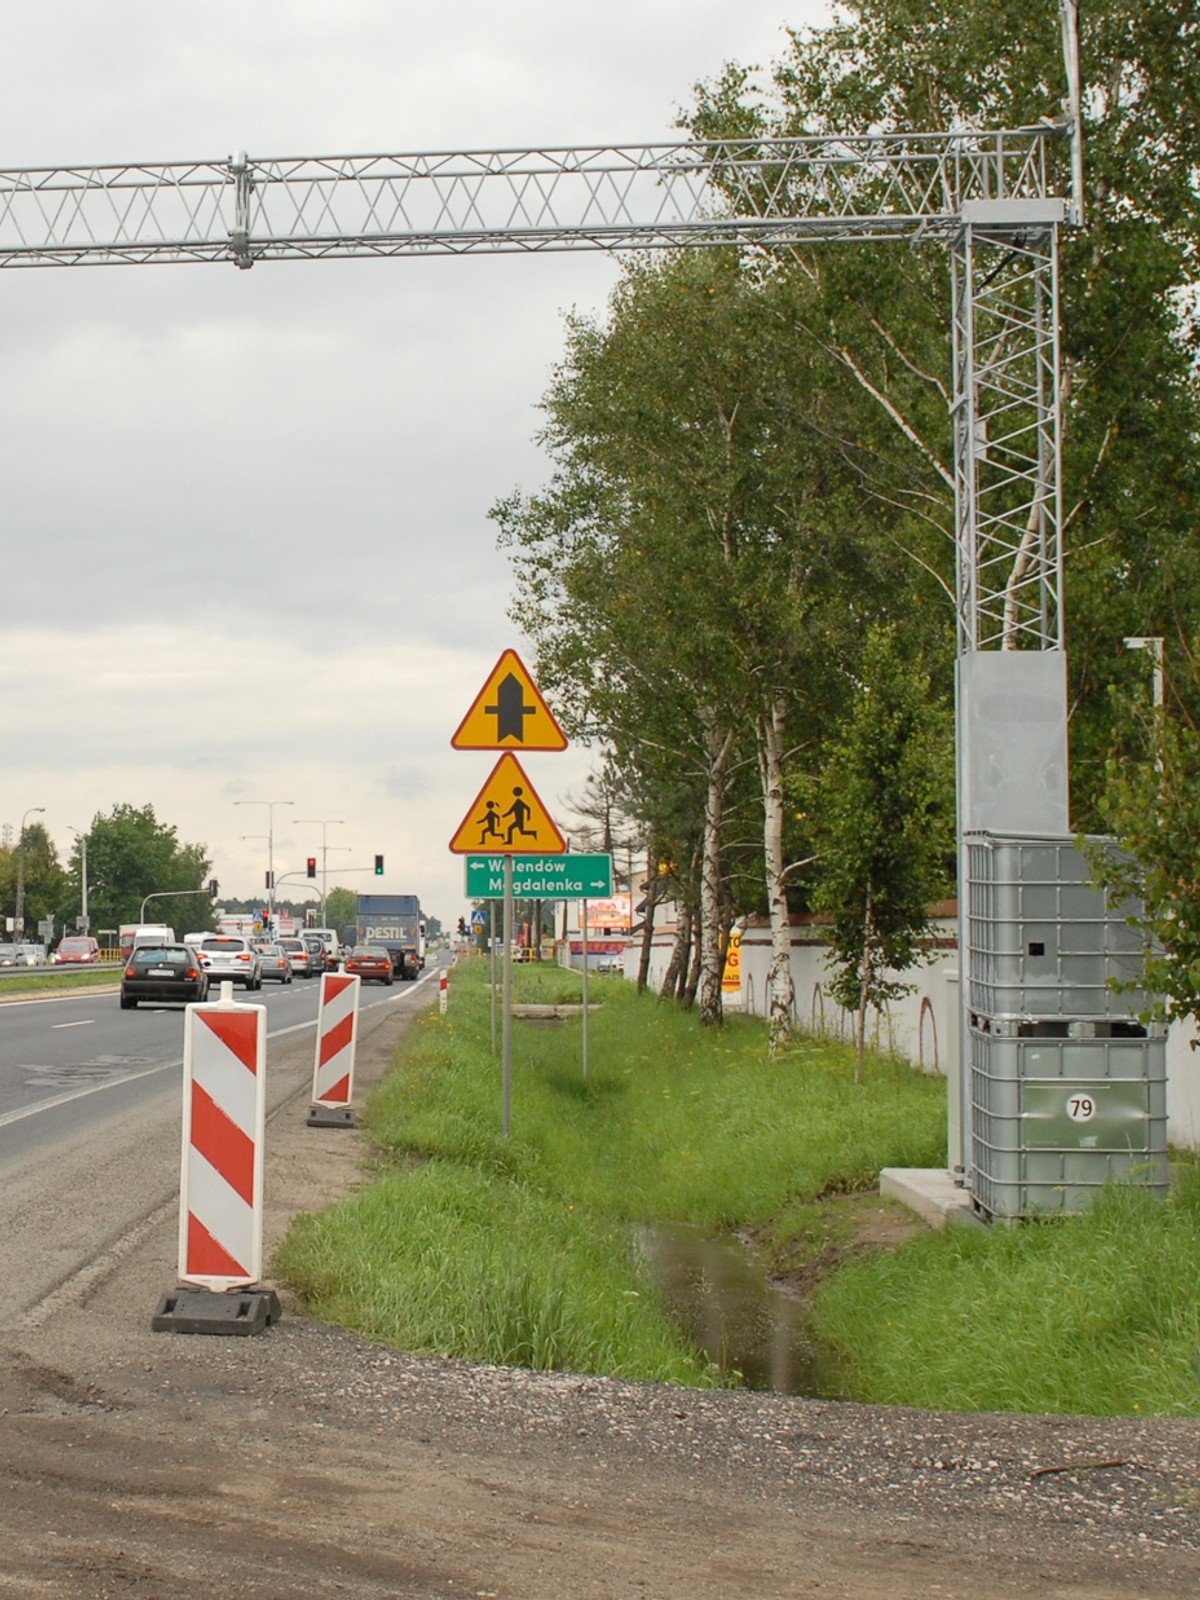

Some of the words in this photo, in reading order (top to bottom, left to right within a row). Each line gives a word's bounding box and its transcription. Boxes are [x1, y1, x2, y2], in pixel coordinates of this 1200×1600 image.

[489, 878, 583, 894] Mgdalenka
[366, 927, 407, 939] DESTIL
[1070, 1099, 1092, 1117] 79
